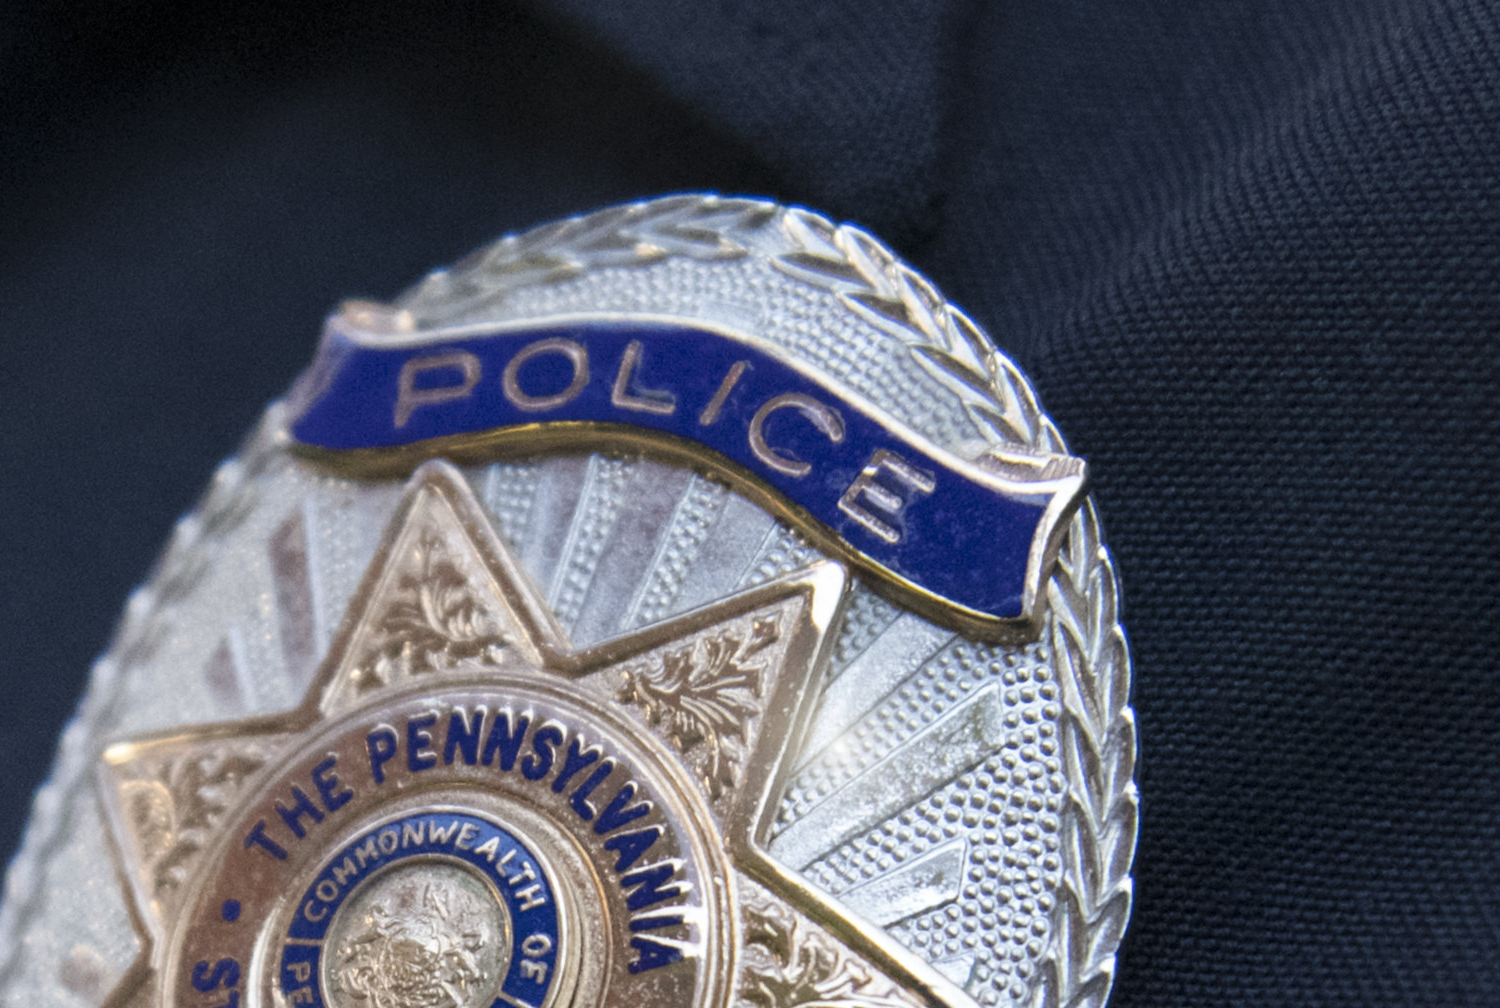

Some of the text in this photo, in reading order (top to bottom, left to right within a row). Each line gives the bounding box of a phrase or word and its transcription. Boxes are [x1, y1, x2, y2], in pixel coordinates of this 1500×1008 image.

[393, 337, 936, 545] POLICE
[245, 707, 690, 974] THE PENNSYLVANIA
[304, 819, 552, 985] COMMONWEALTH OF
